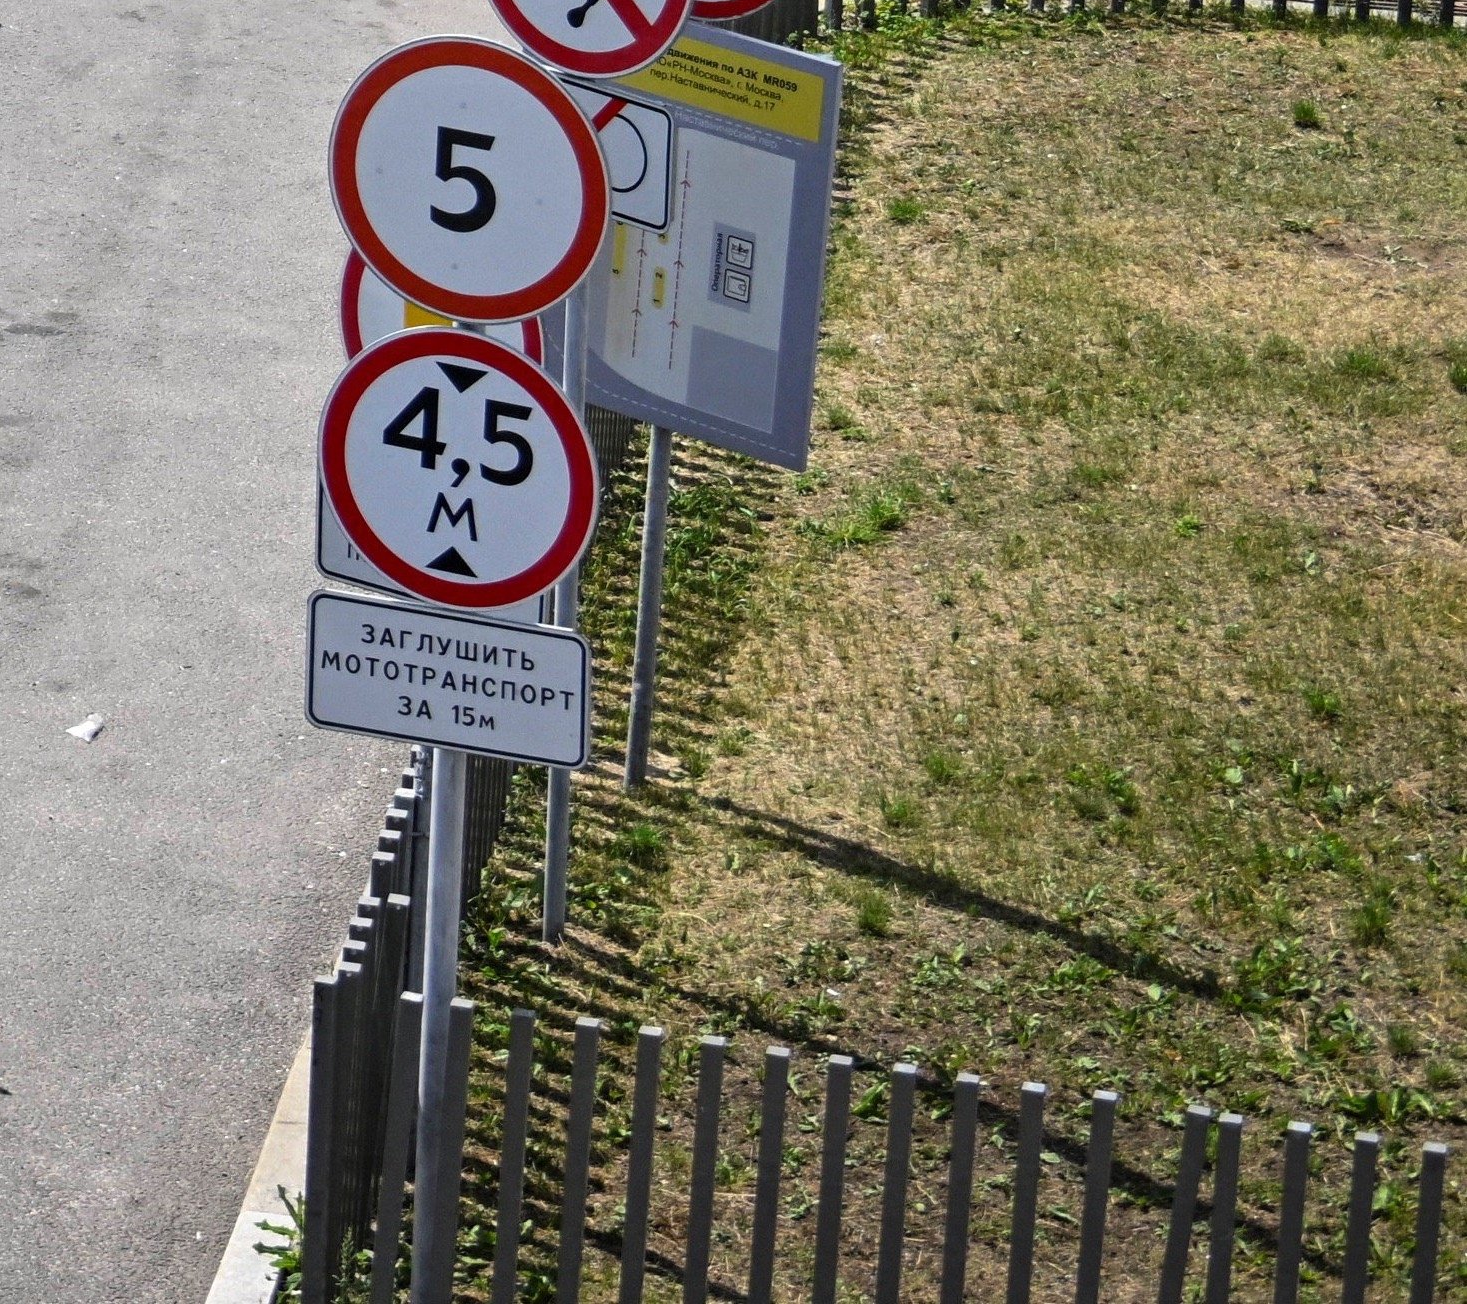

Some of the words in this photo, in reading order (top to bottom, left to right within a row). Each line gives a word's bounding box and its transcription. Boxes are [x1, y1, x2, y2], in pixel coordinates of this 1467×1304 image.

[666, 48, 719, 69] движения
[721, 63, 734, 74] по
[737, 67, 758, 81] АЗК
[762, 73, 798, 93] MR059
[429, 124, 497, 233] 5
[383, 386, 534, 489] 4,5
[361, 623, 535, 671] ЗАГЛУШИТЬ
[321, 650, 574, 711] МОТОТРАНСПОРТ
[397, 695, 433, 720] ЗА
